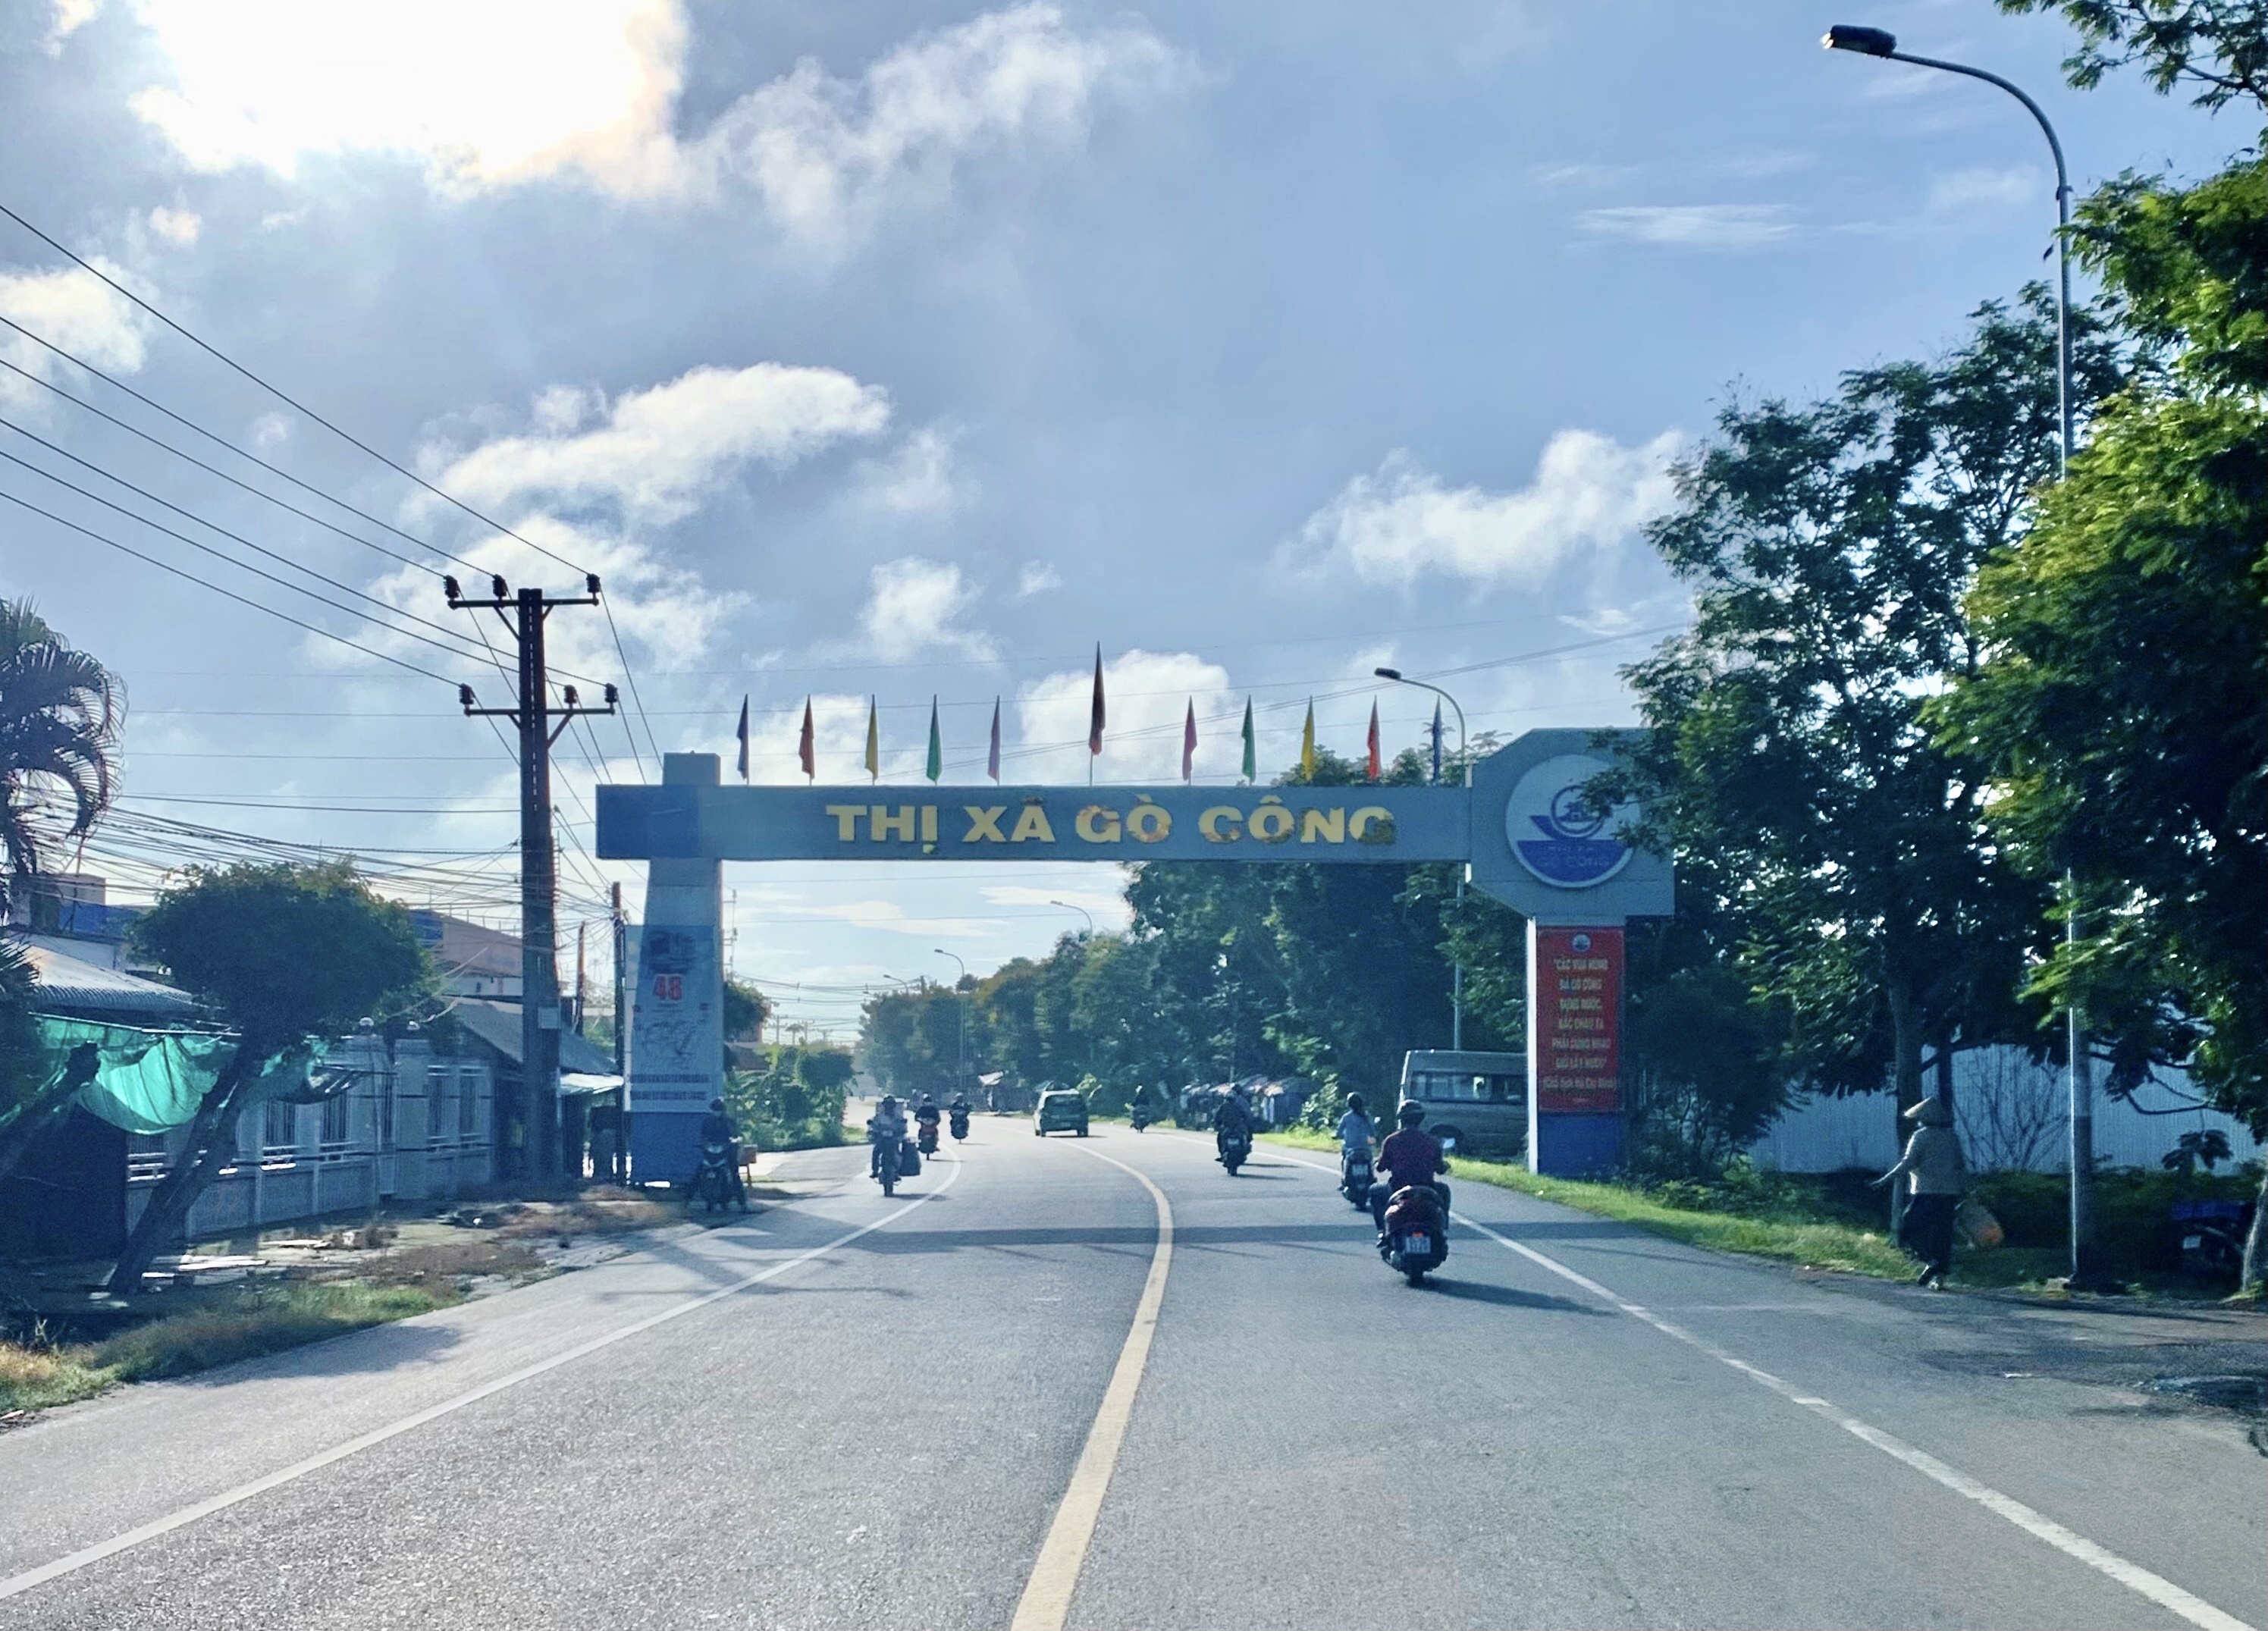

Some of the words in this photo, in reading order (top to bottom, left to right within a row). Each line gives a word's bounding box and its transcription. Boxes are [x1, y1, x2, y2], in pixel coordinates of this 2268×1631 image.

[826, 805, 939, 855] THỊ
[1075, 793, 1173, 844] GÒ
[1198, 794, 1397, 845] CÔNG
